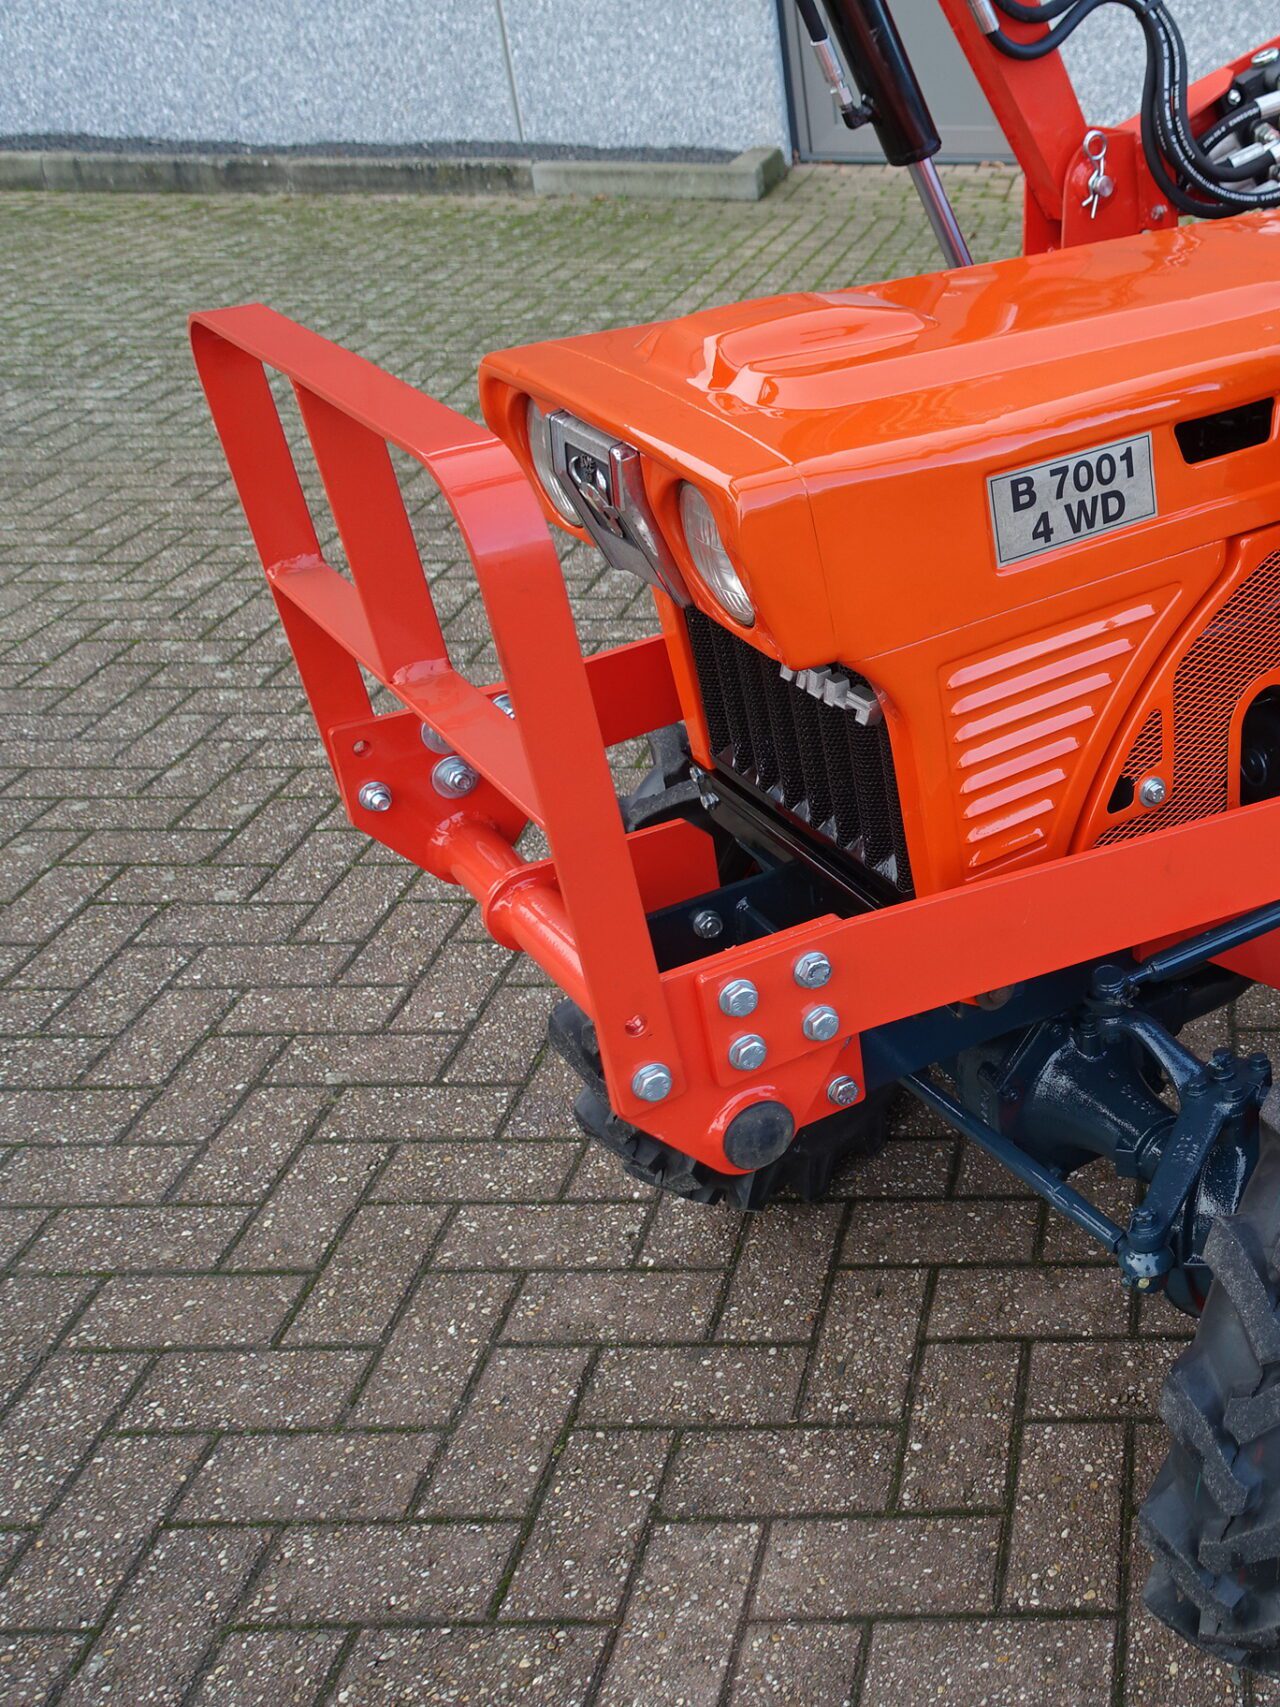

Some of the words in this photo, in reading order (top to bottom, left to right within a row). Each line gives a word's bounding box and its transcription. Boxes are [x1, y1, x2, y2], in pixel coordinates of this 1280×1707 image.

[1010, 476, 1037, 513] B
[1049, 446, 1135, 500] 7001
[1032, 511, 1054, 543] 4
[1064, 489, 1126, 534] WD
